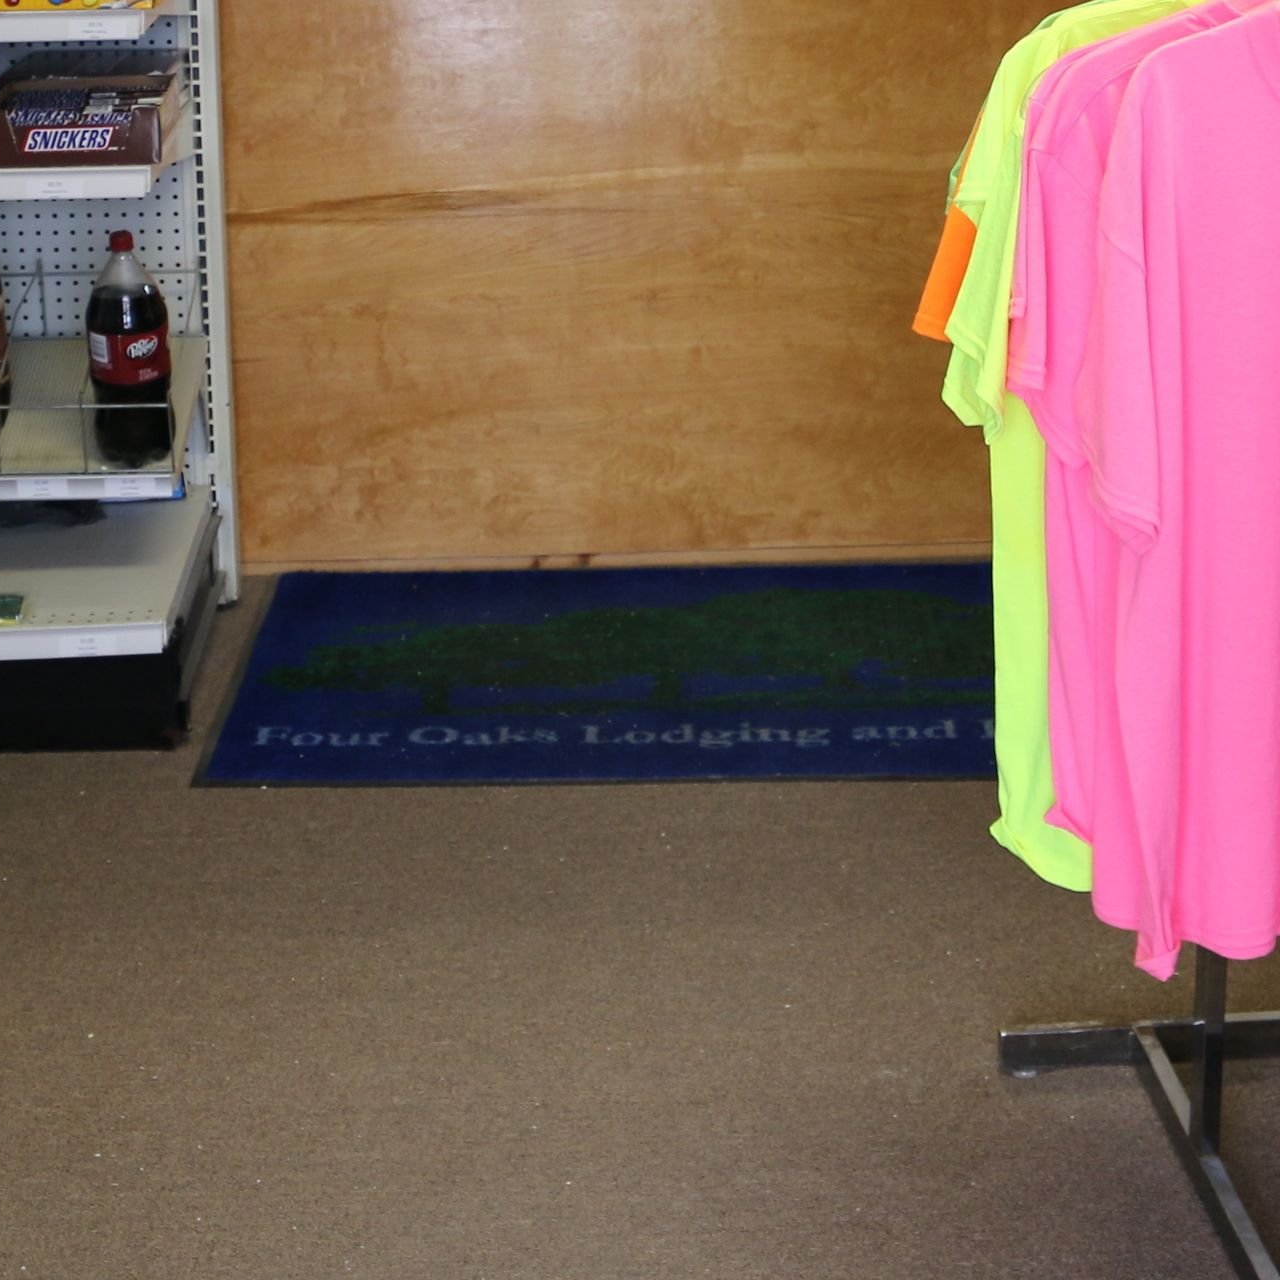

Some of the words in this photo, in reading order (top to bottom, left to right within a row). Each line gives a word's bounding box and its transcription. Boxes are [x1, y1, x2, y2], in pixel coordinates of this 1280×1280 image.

[28, 129, 109, 151] SNICKERS
[254, 724, 390, 748] Four
[409, 723, 559, 747] Oaks
[580, 720, 831, 750] Lodging
[852, 717, 957, 741] and
